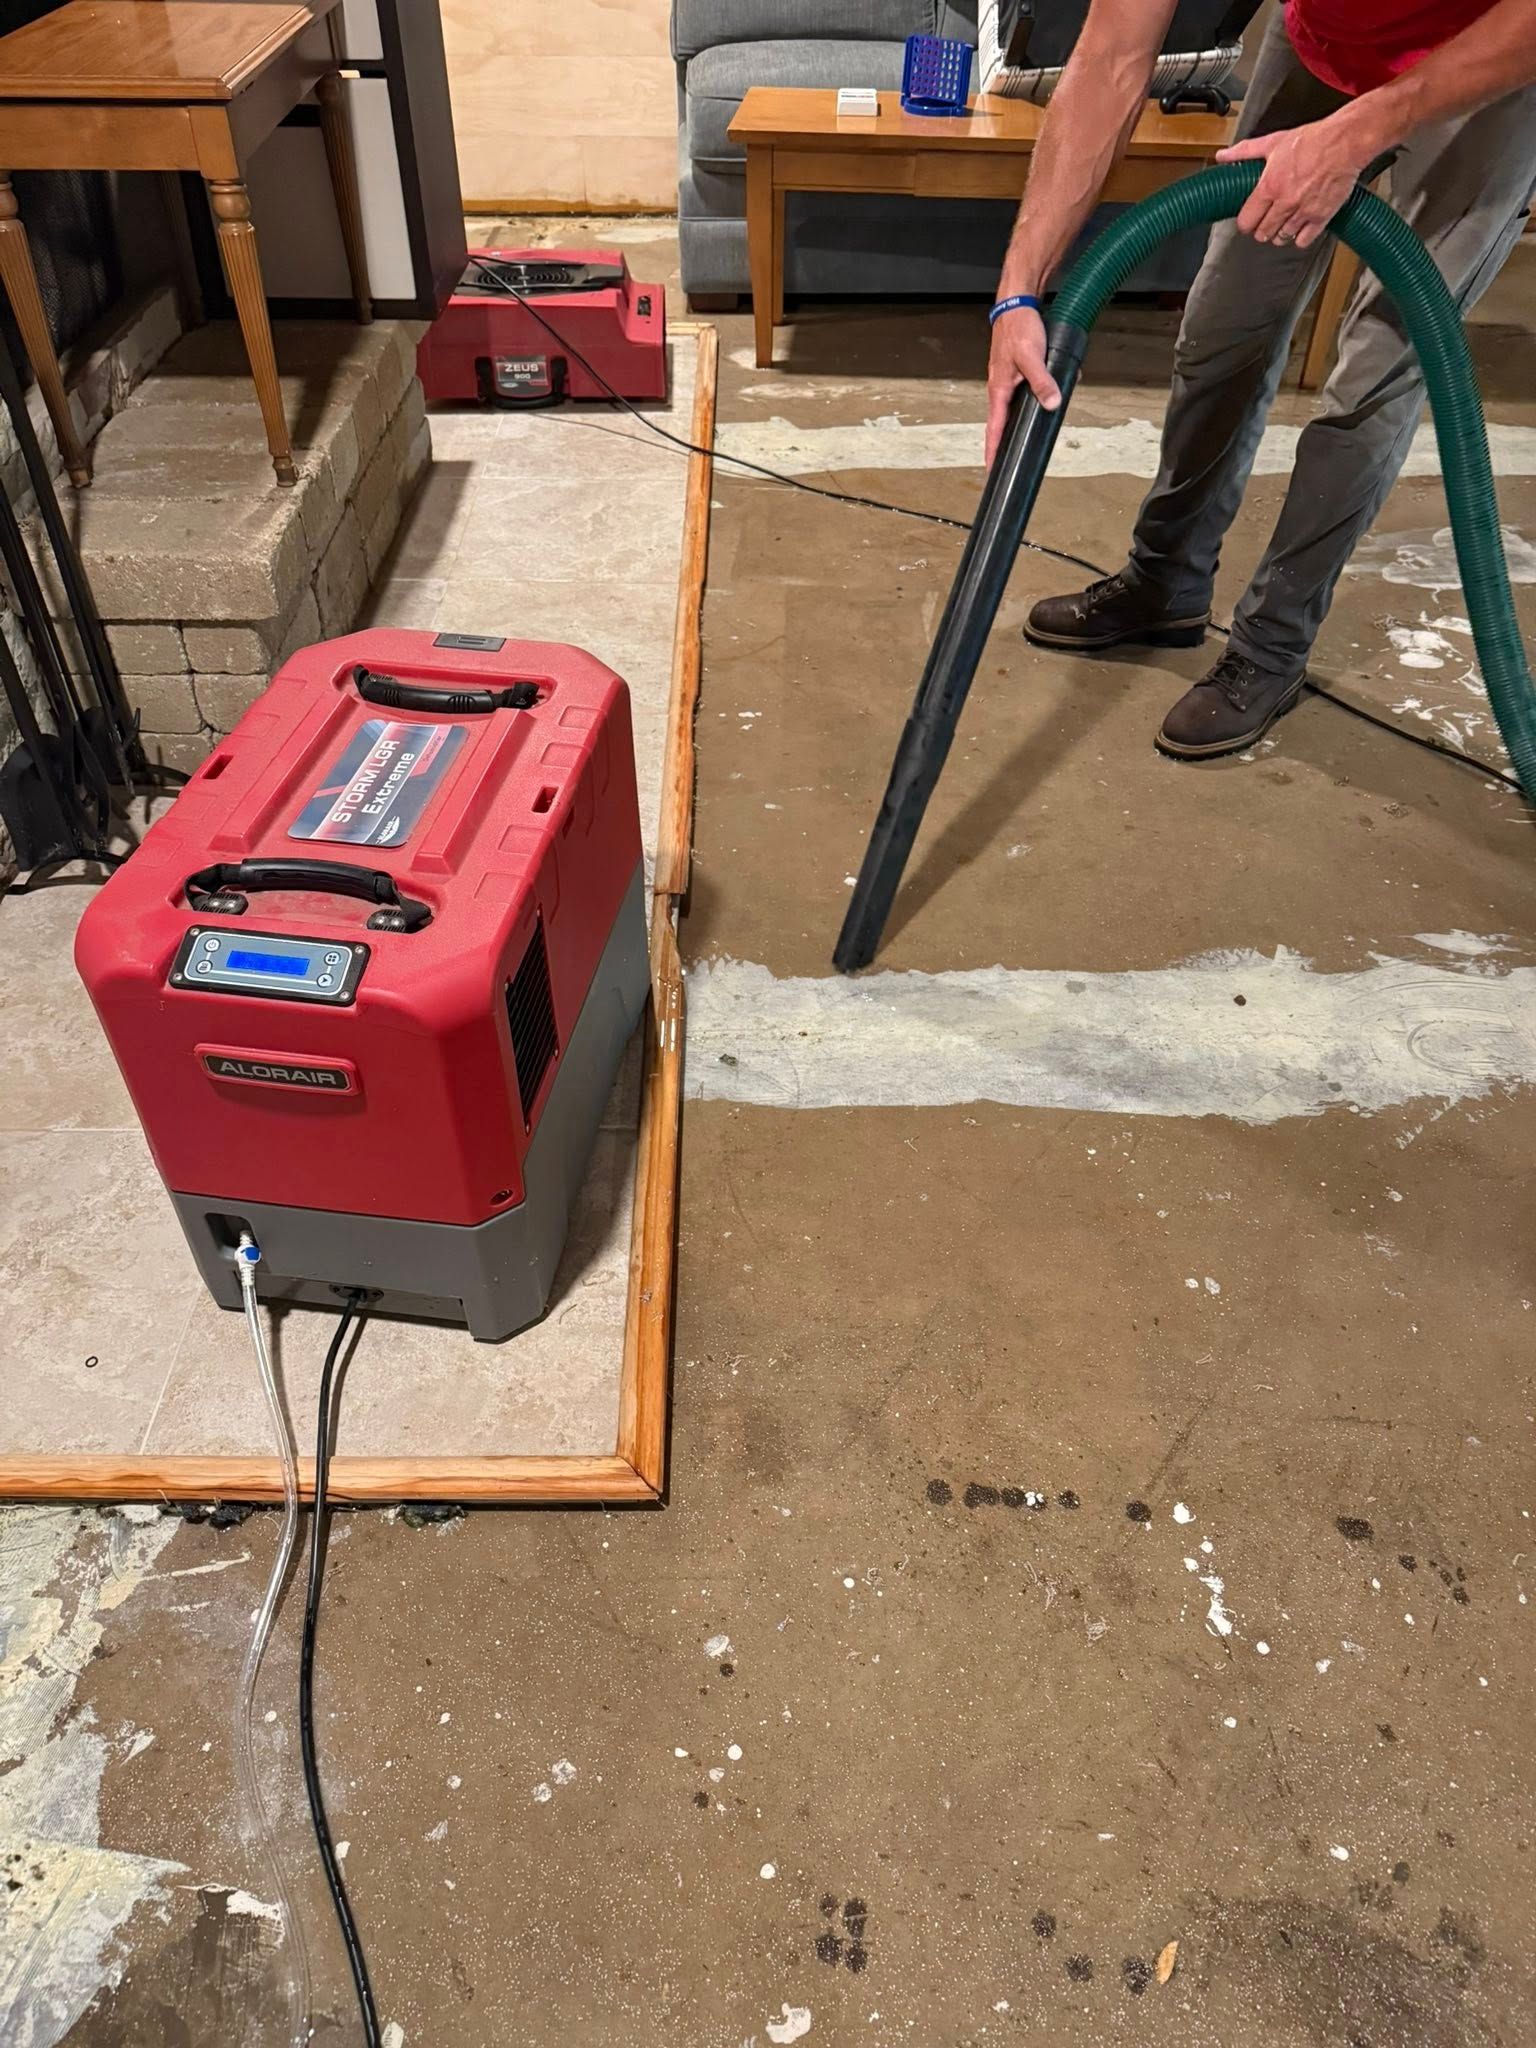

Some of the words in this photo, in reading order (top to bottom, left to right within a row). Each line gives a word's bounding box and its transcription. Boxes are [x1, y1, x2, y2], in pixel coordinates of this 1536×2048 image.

[504, 363, 539, 372] ZEUS
[331, 768, 380, 823] STORM
[369, 740, 401, 768] LGR
[361, 752, 415, 814] Extreme
[220, 1061, 337, 1085] ALORAIR
